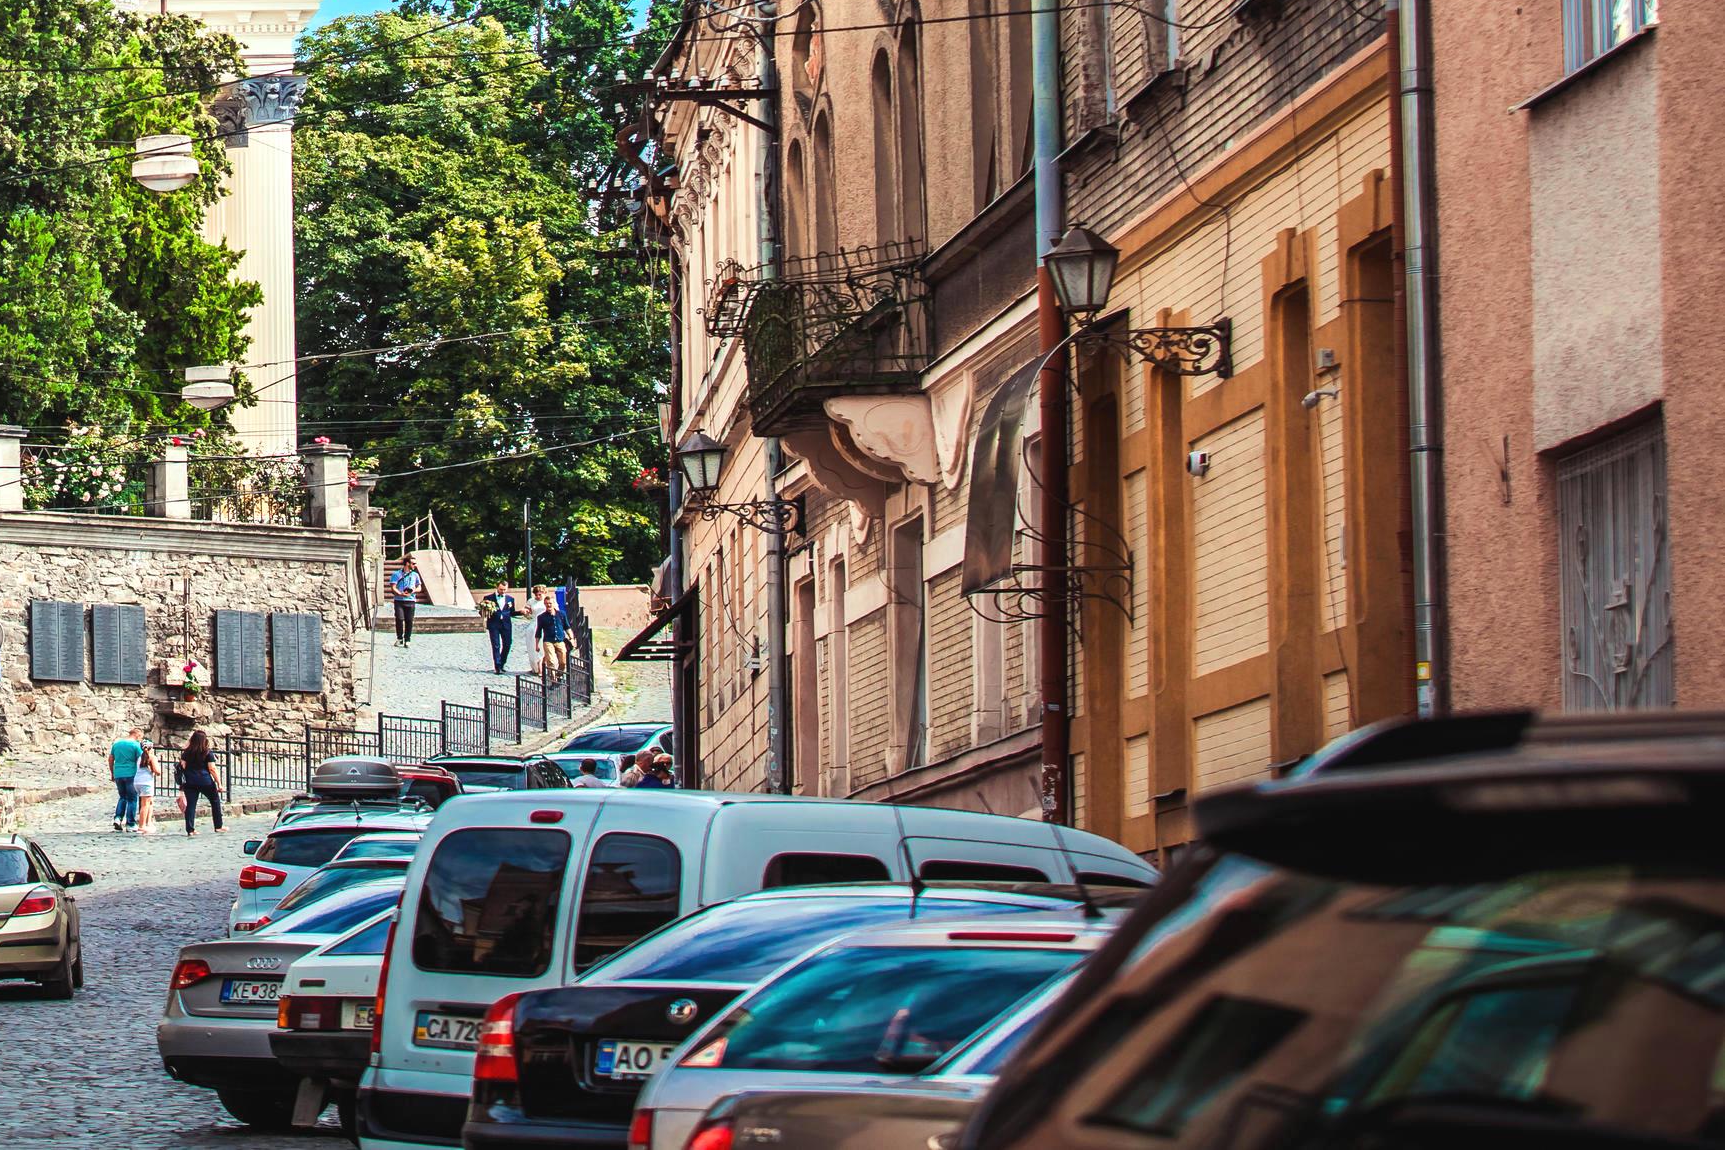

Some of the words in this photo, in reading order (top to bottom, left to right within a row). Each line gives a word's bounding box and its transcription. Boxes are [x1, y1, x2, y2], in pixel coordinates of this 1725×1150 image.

[231, 982, 251, 999] KE
[427, 1018, 451, 1040] CA
[615, 1045, 653, 1070] AO
